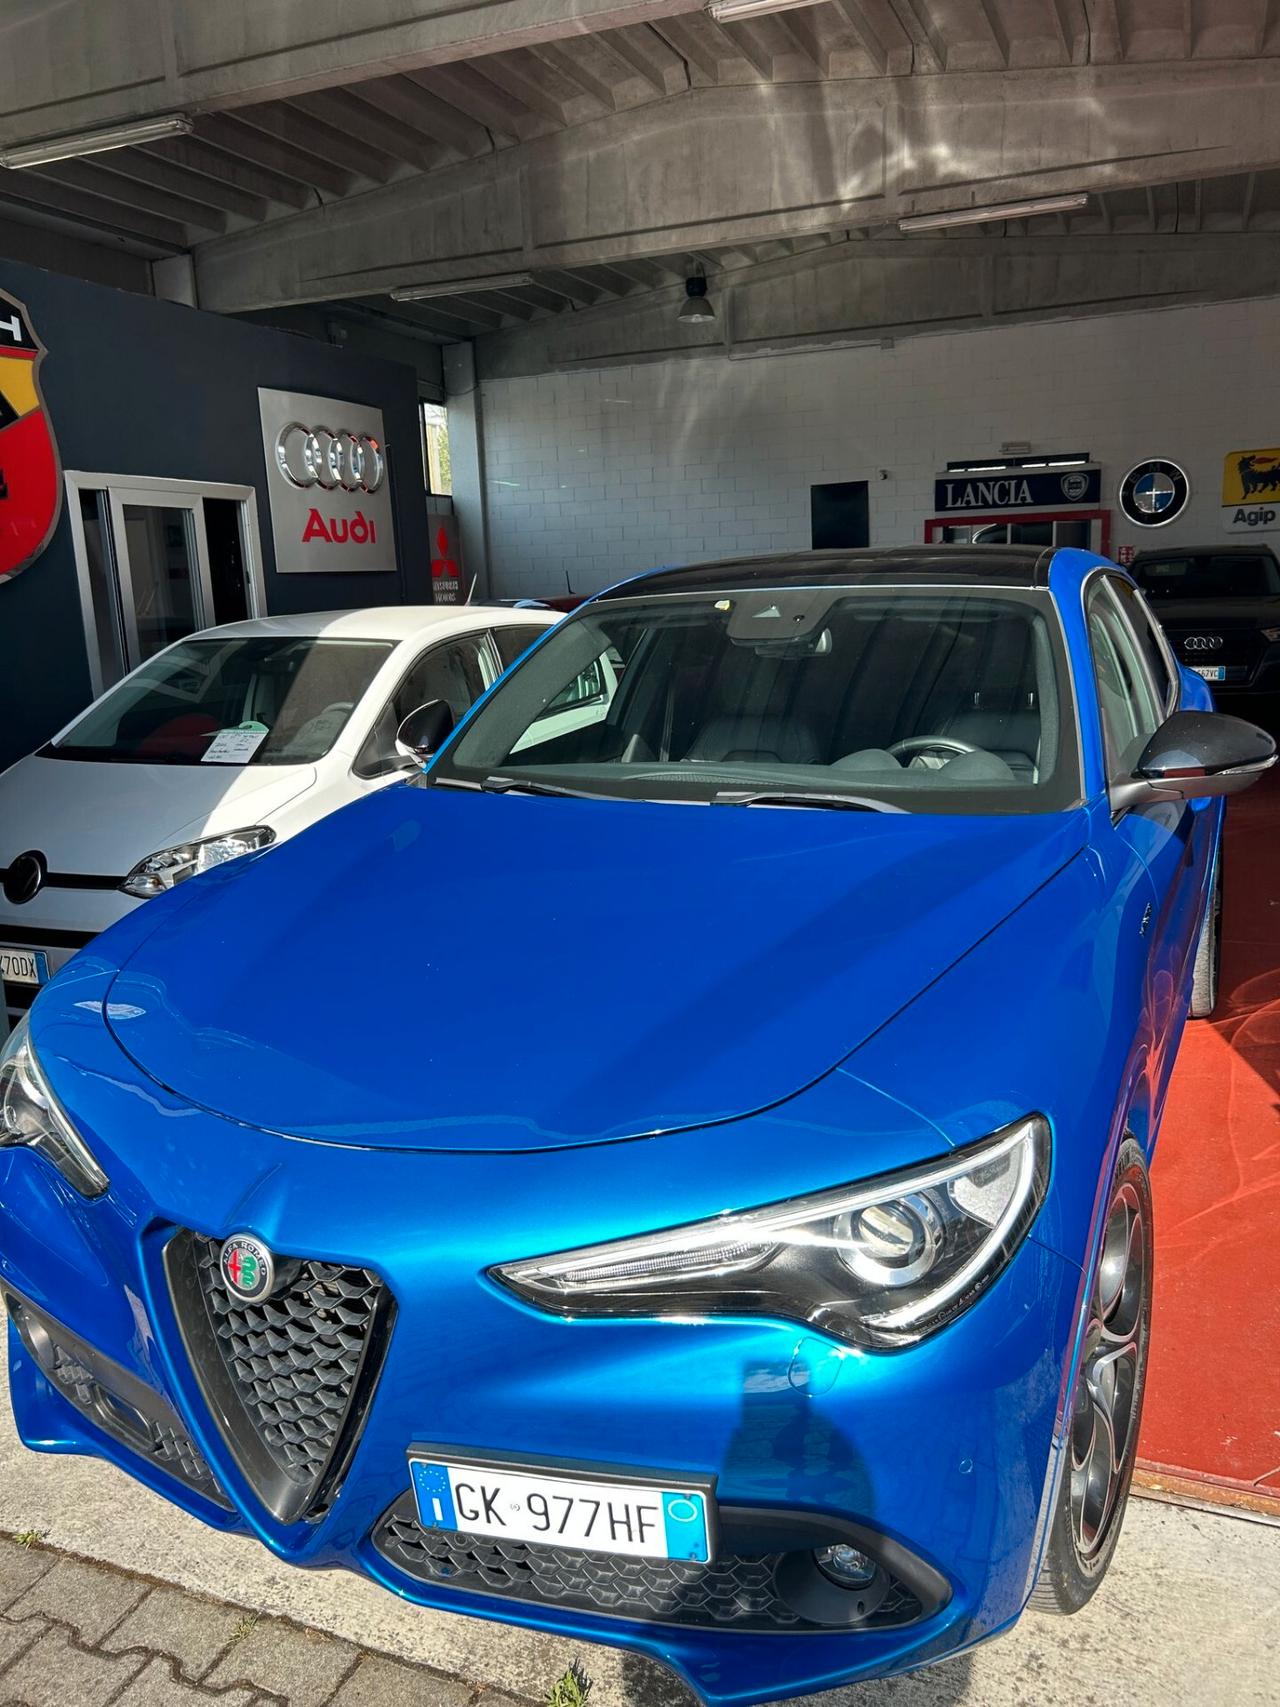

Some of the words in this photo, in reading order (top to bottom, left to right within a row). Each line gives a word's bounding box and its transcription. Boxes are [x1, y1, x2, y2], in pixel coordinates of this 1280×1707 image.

[945, 479, 1034, 508] LANCIA
[302, 507, 376, 544] Audi
[1233, 507, 1276, 526] Agip
[223, 1243, 238, 1264] ALFA
[241, 1241, 267, 1276] ROMEO
[454, 1482, 507, 1526] GK
[526, 1492, 659, 1543] 977HF
